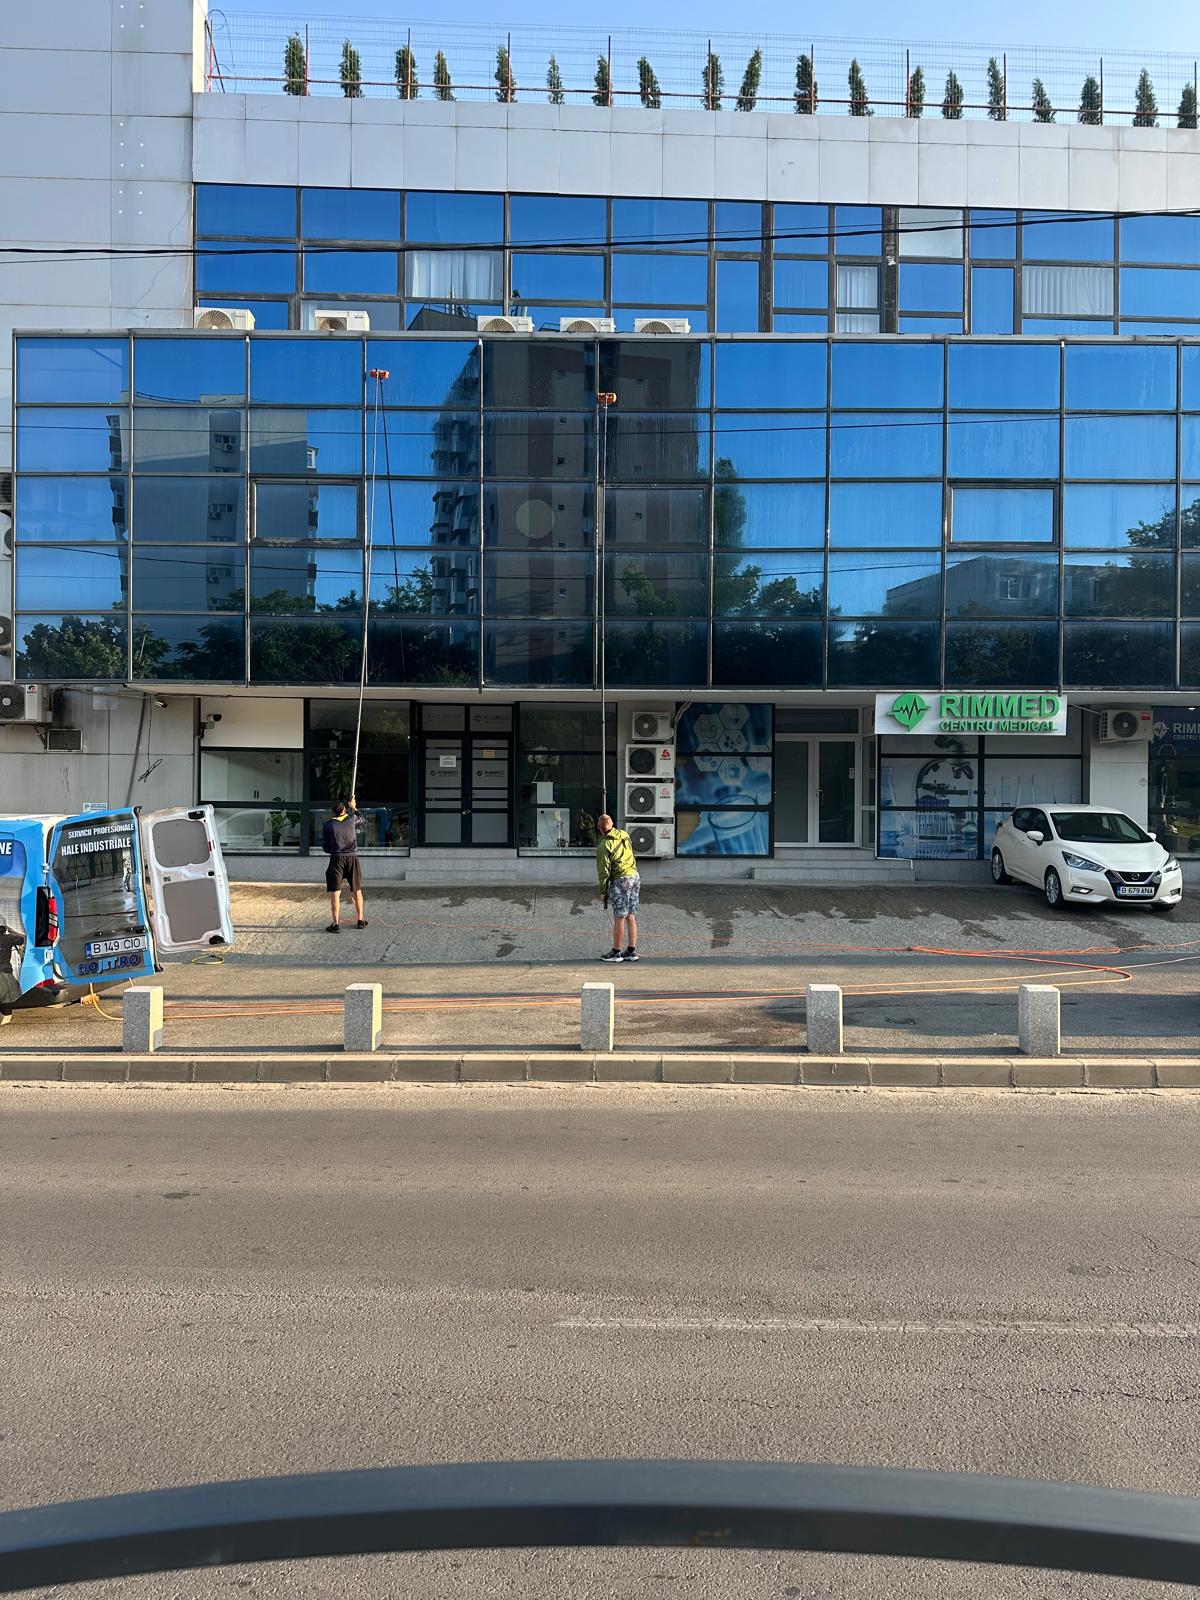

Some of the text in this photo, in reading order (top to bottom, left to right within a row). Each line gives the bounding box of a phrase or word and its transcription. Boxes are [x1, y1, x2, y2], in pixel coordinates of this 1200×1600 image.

[939, 694, 1060, 718] RIMMED
[939, 720, 1058, 733] CENTRU MEDICAL
[1172, 722, 1200, 734] RIM
[68, 823, 134, 839] SERVICII PROFESIONALE
[61, 837, 131, 856] HALE INDUSTRIALE
[93, 937, 141, 954] B 149 CIO
